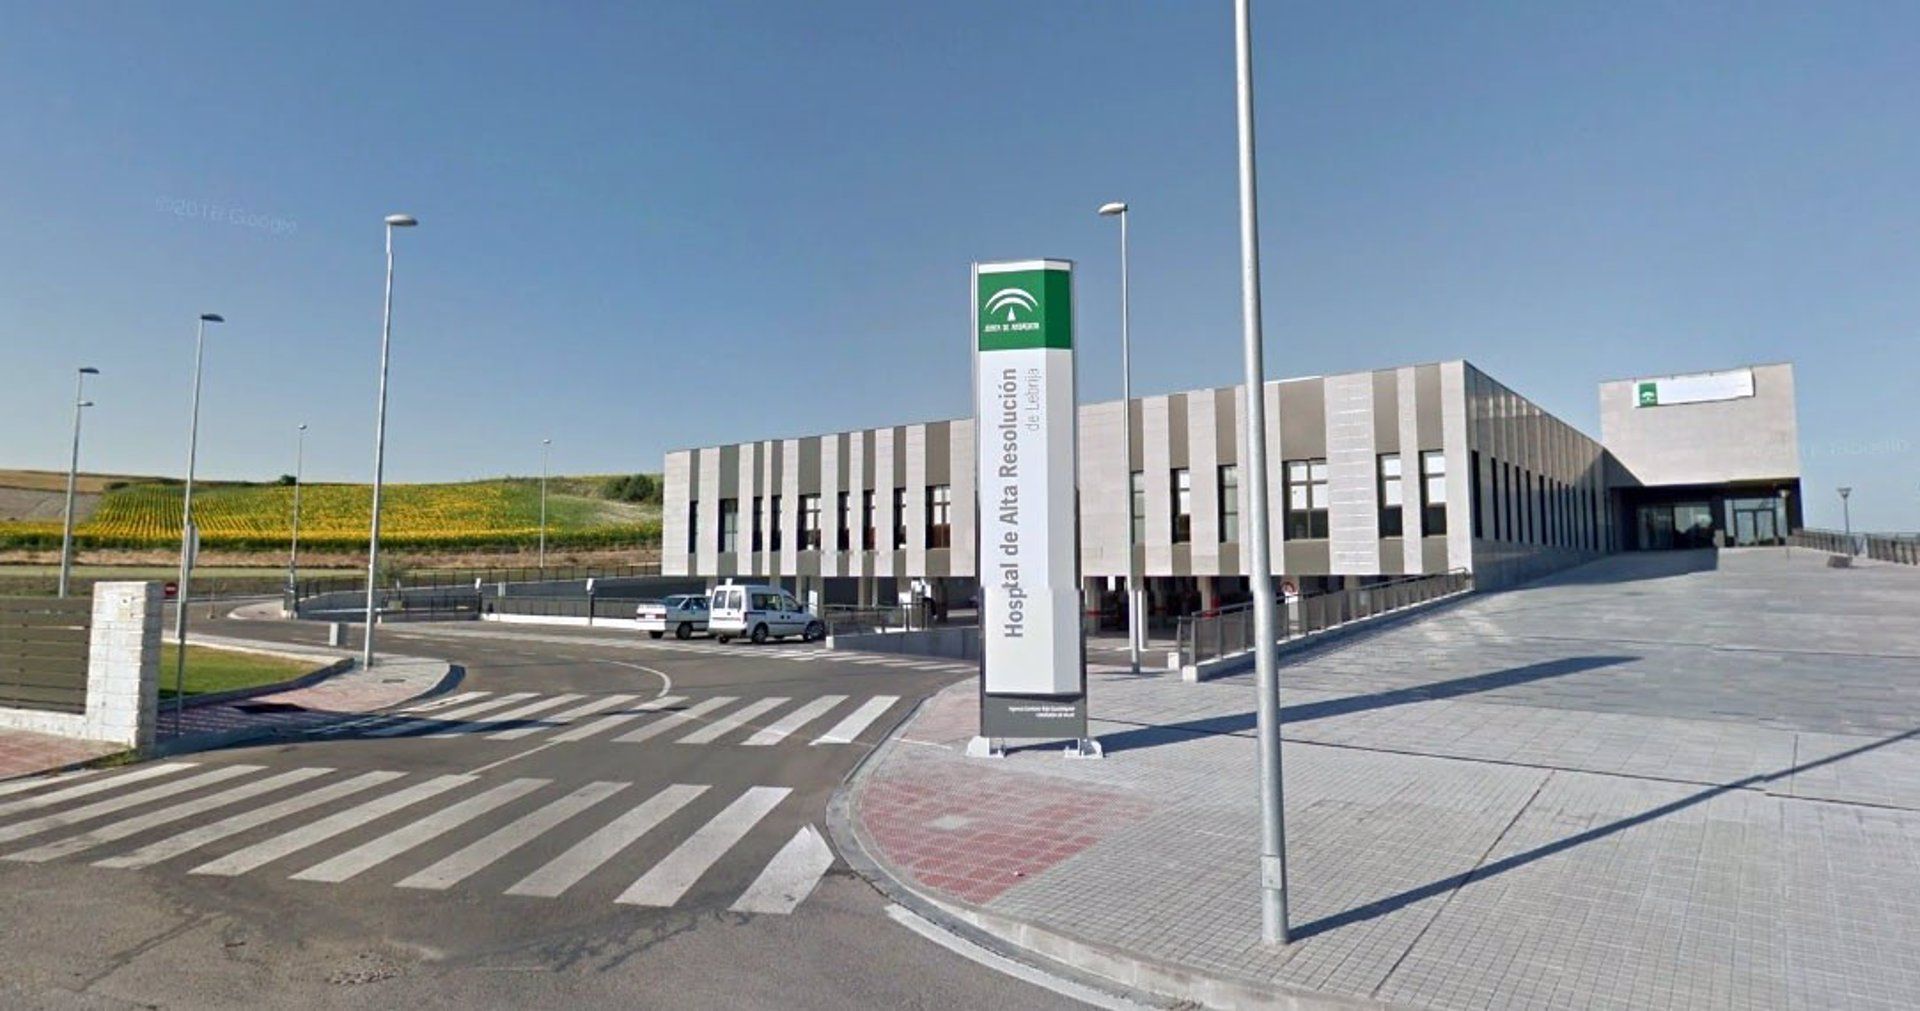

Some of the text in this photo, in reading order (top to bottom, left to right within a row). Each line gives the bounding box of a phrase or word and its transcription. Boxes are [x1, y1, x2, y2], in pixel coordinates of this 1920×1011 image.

[998, 368, 1018, 478] Resolución
[1024, 415, 1040, 431] de
[999, 484, 1019, 525] Alta
[999, 531, 1019, 556] de
